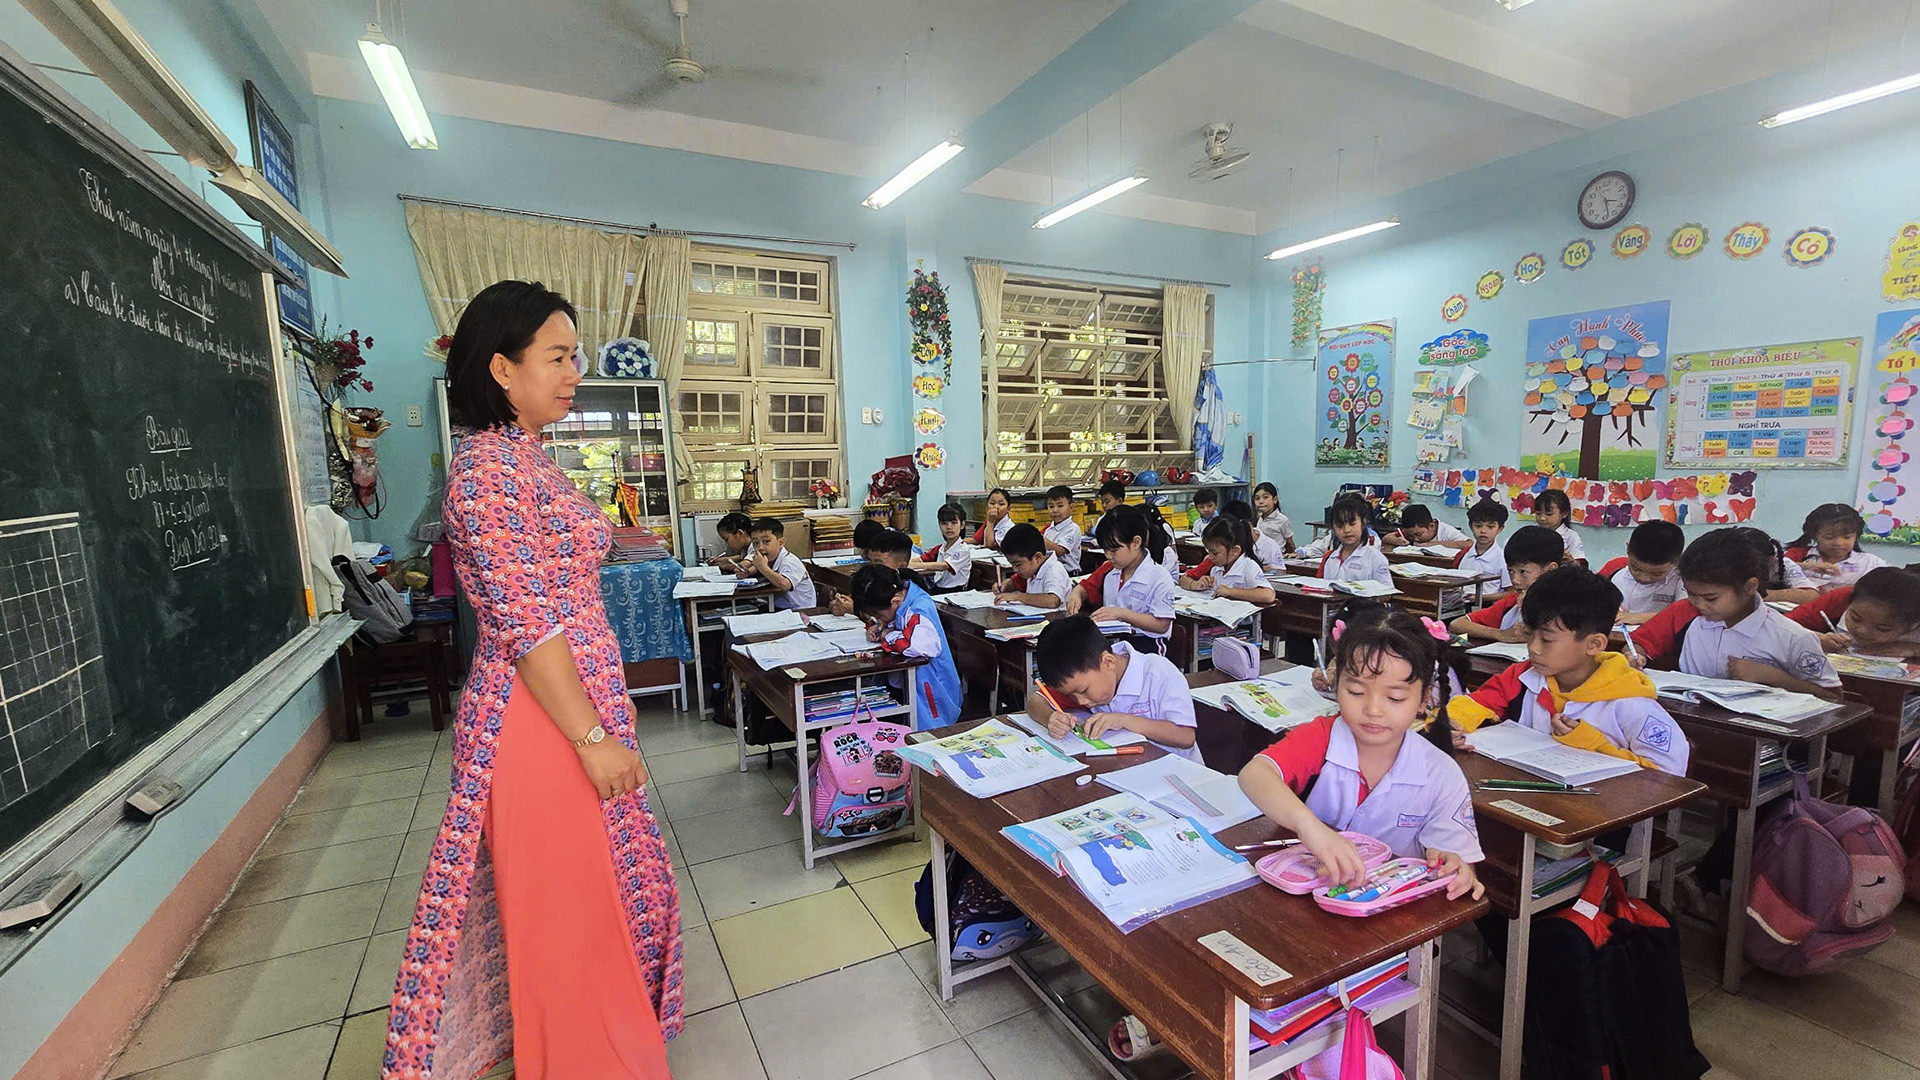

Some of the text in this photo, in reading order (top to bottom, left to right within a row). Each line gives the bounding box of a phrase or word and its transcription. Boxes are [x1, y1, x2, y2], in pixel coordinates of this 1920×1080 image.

[1618, 235, 1644, 249] Vâng
[1796, 237, 1821, 255] Cô
[1442, 336, 1465, 348] Góc
[1430, 350, 1456, 361] sáng
[1738, 420, 1781, 429] NGHỈ TRƯA
[833, 732, 860, 748] ROCK
